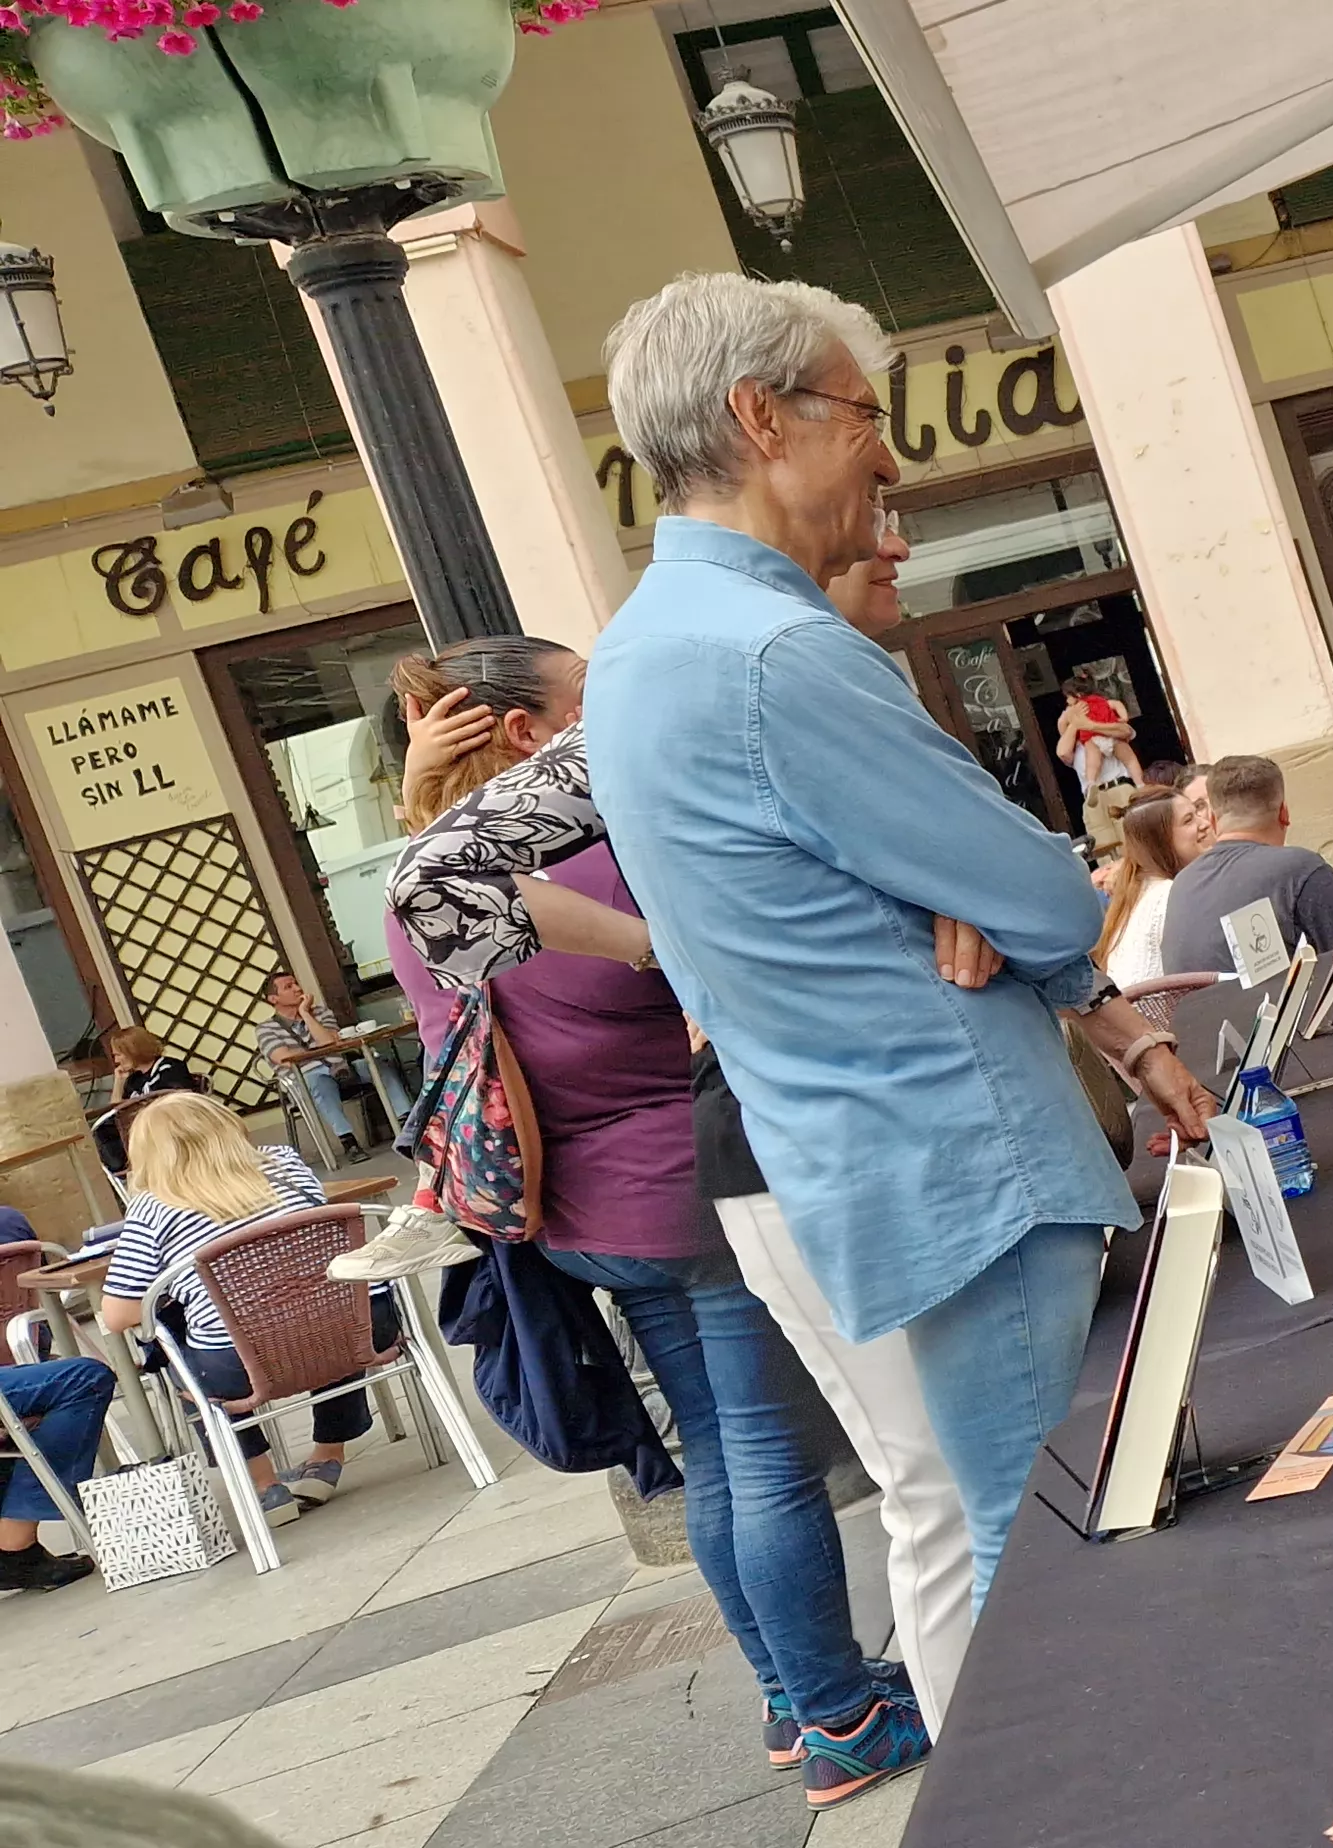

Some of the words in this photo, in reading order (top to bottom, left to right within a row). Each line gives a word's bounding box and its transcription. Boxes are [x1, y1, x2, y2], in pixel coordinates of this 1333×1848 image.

[91, 490, 326, 616] Café
[947, 646, 994, 672] Café
[46, 696, 179, 746] LLÁMAME
[71, 741, 139, 775] PERO
[81, 779, 124, 807] SIN
[132, 763, 176, 797] LL
